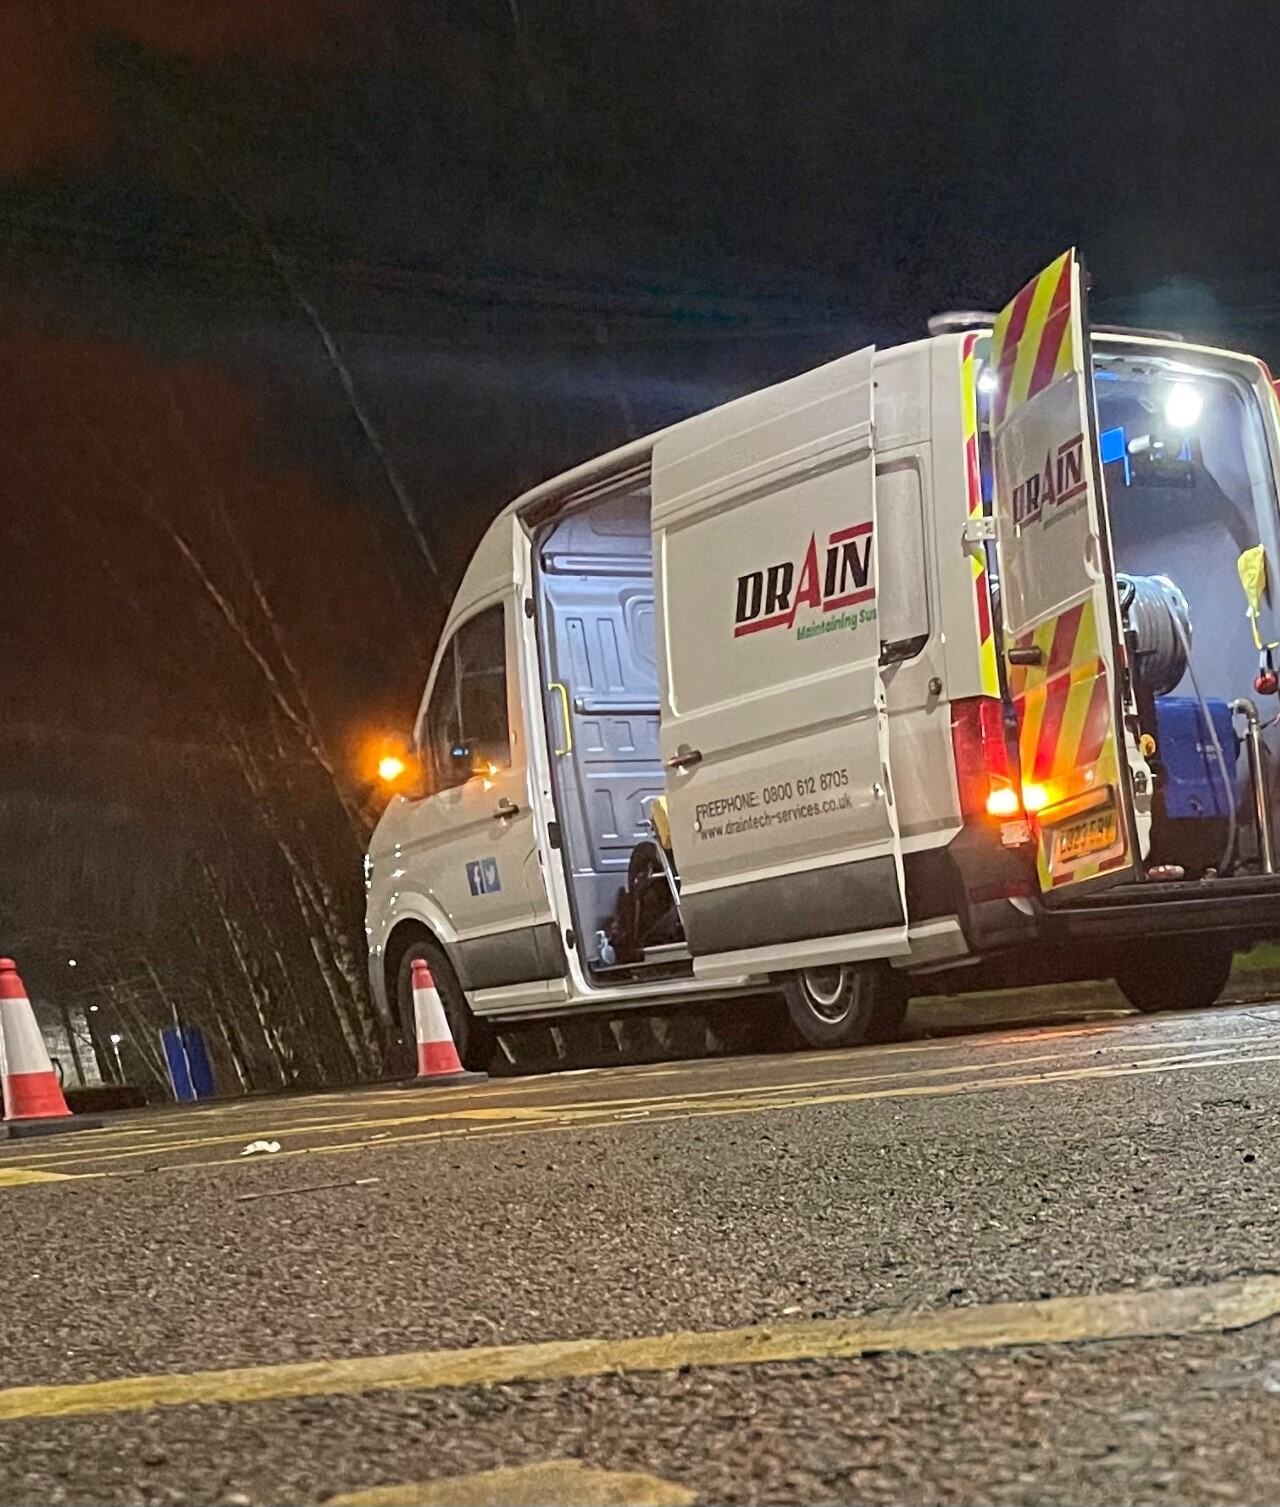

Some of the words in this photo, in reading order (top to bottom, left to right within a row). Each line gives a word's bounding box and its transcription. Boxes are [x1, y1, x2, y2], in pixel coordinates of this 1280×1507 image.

[1013, 448, 1083, 525] DRAIN
[735, 530, 872, 624] DRAIN
[796, 612, 857, 640] Maintaining
[695, 791, 760, 821] FREEPHONE:
[763, 782, 792, 804] 0800
[797, 776, 816, 796] 612
[819, 769, 848, 791] 8705
[701, 792, 852, 840] www.draintech-services.co.uk
